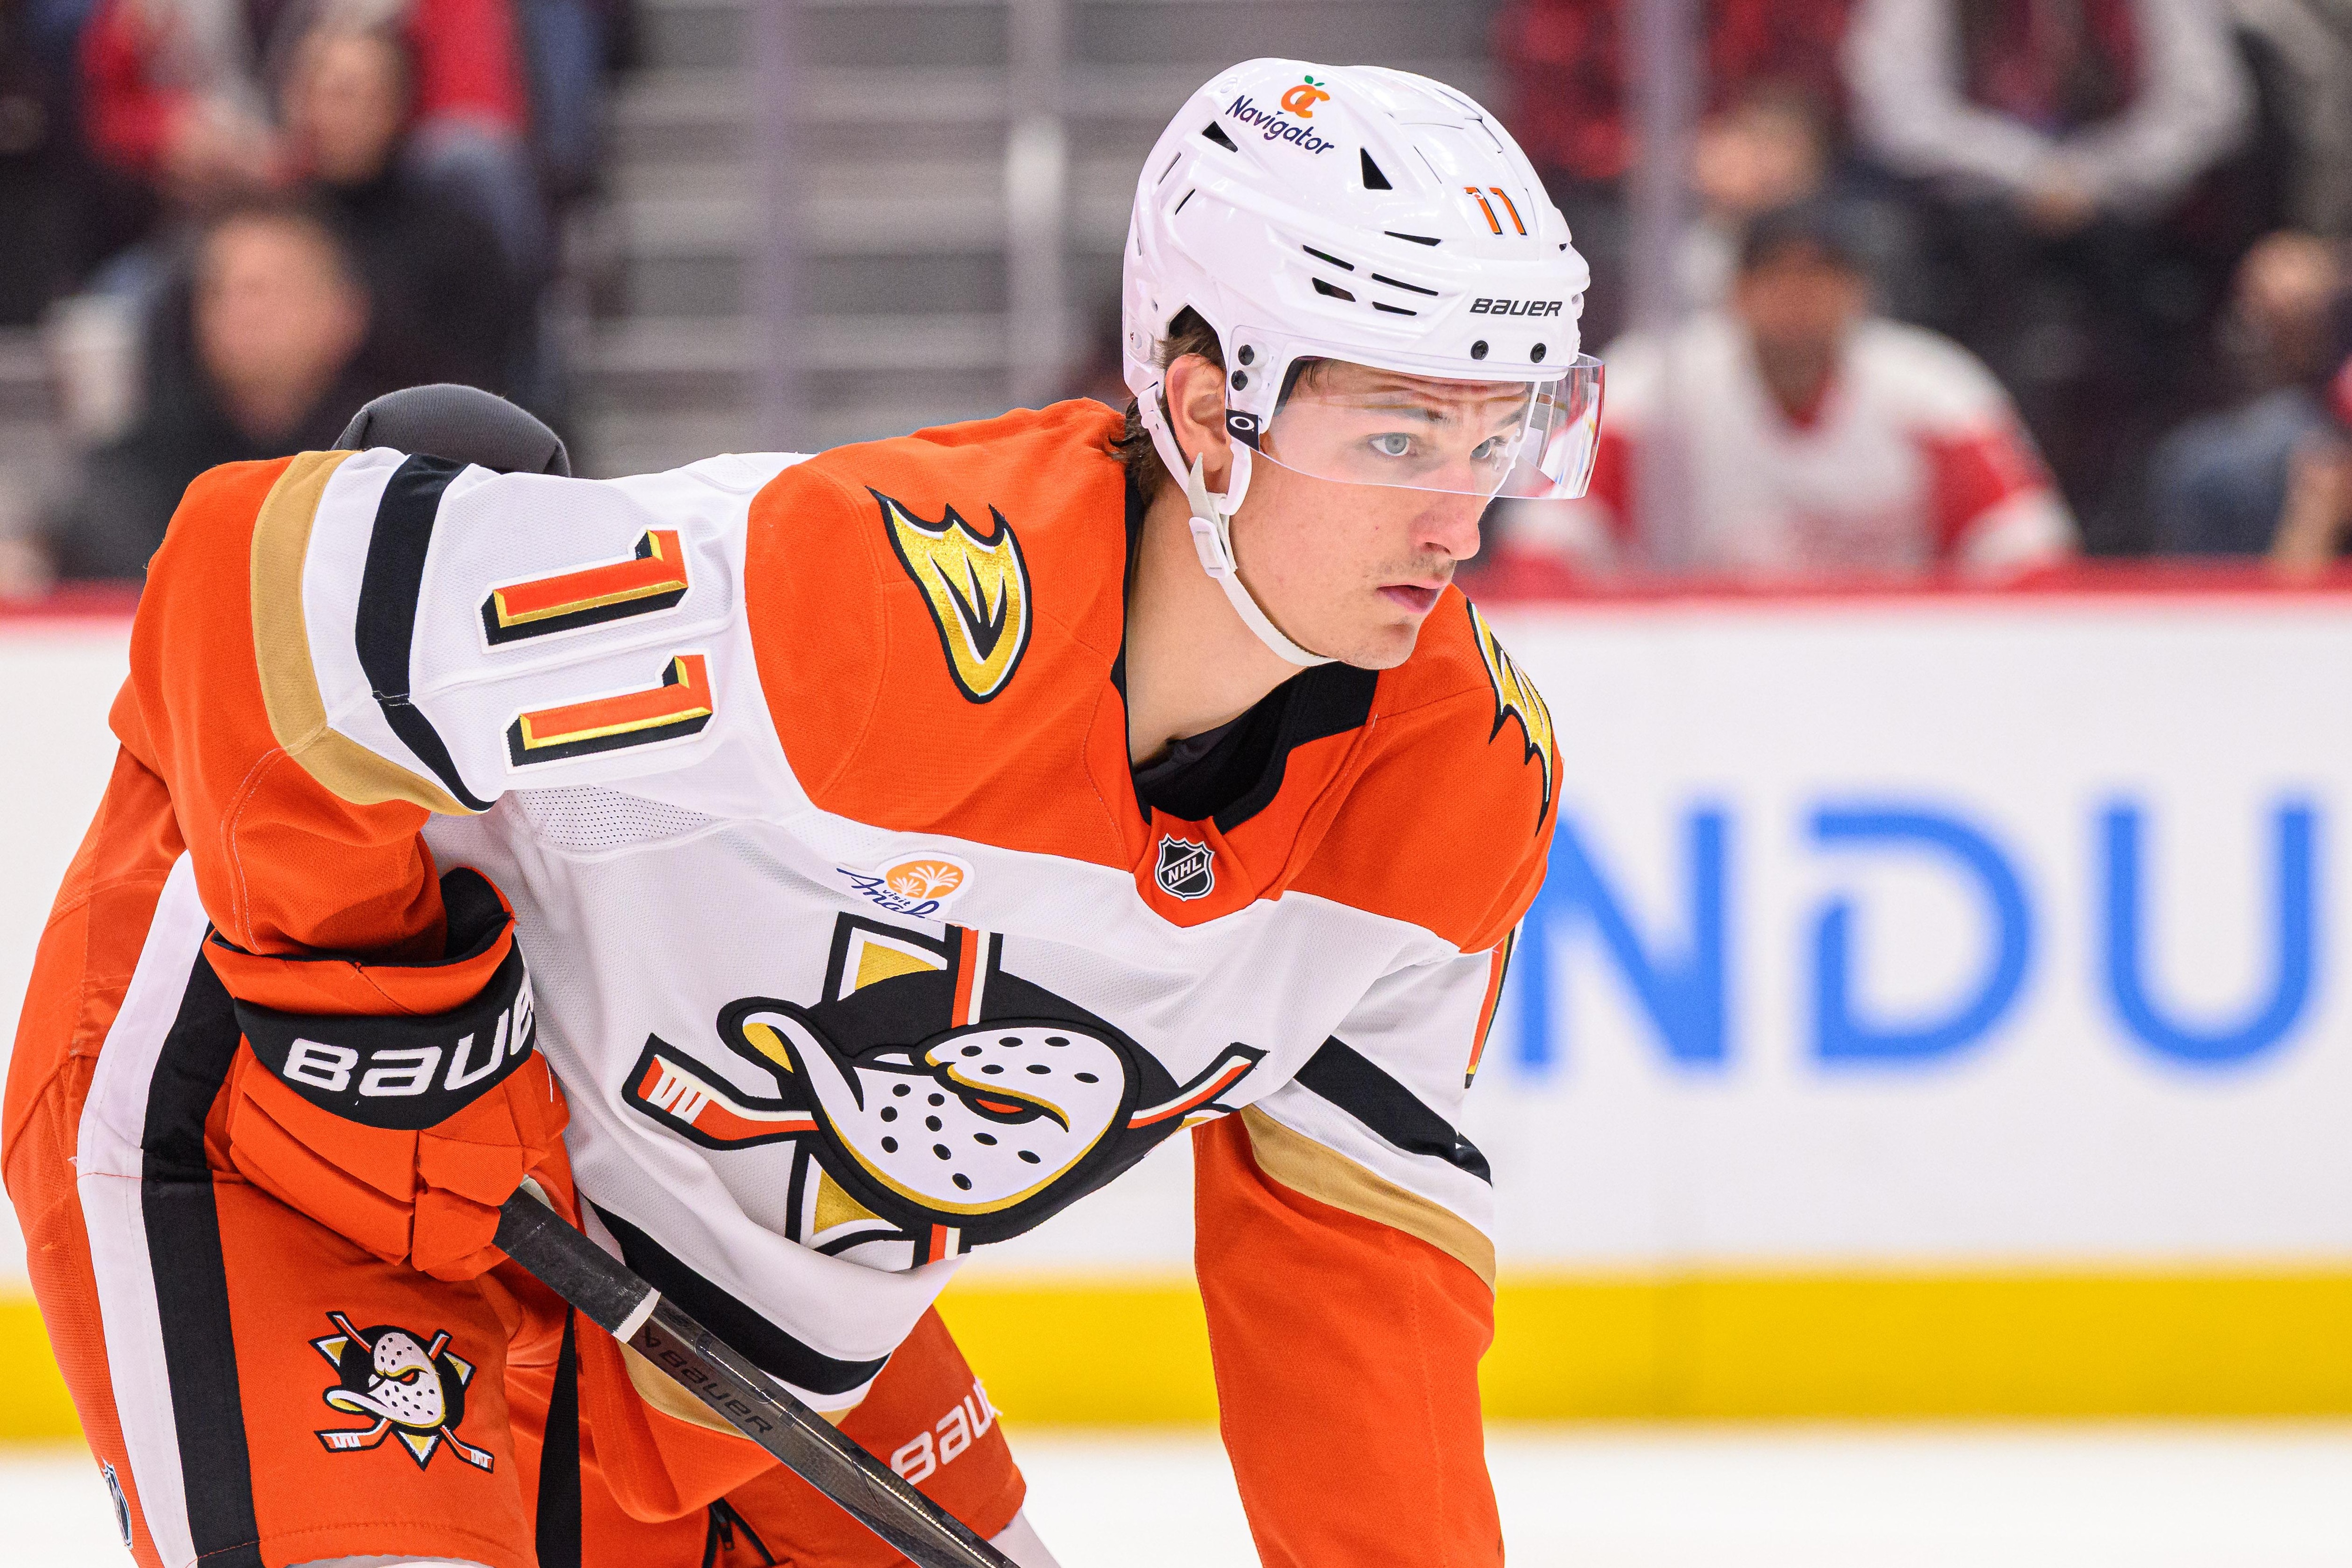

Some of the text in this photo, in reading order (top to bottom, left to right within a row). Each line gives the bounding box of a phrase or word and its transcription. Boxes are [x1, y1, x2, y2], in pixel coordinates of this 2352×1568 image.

[1225, 95, 1335, 154] Navigator
[1463, 187, 1528, 236] 11
[1469, 298, 1563, 317] BAUER
[480, 529, 714, 768] 11
[882, 889, 911, 906] visit
[1168, 857, 1202, 884] NHL
[283, 967, 535, 1097] BAUE
[890, 1379, 993, 1486] BAU
